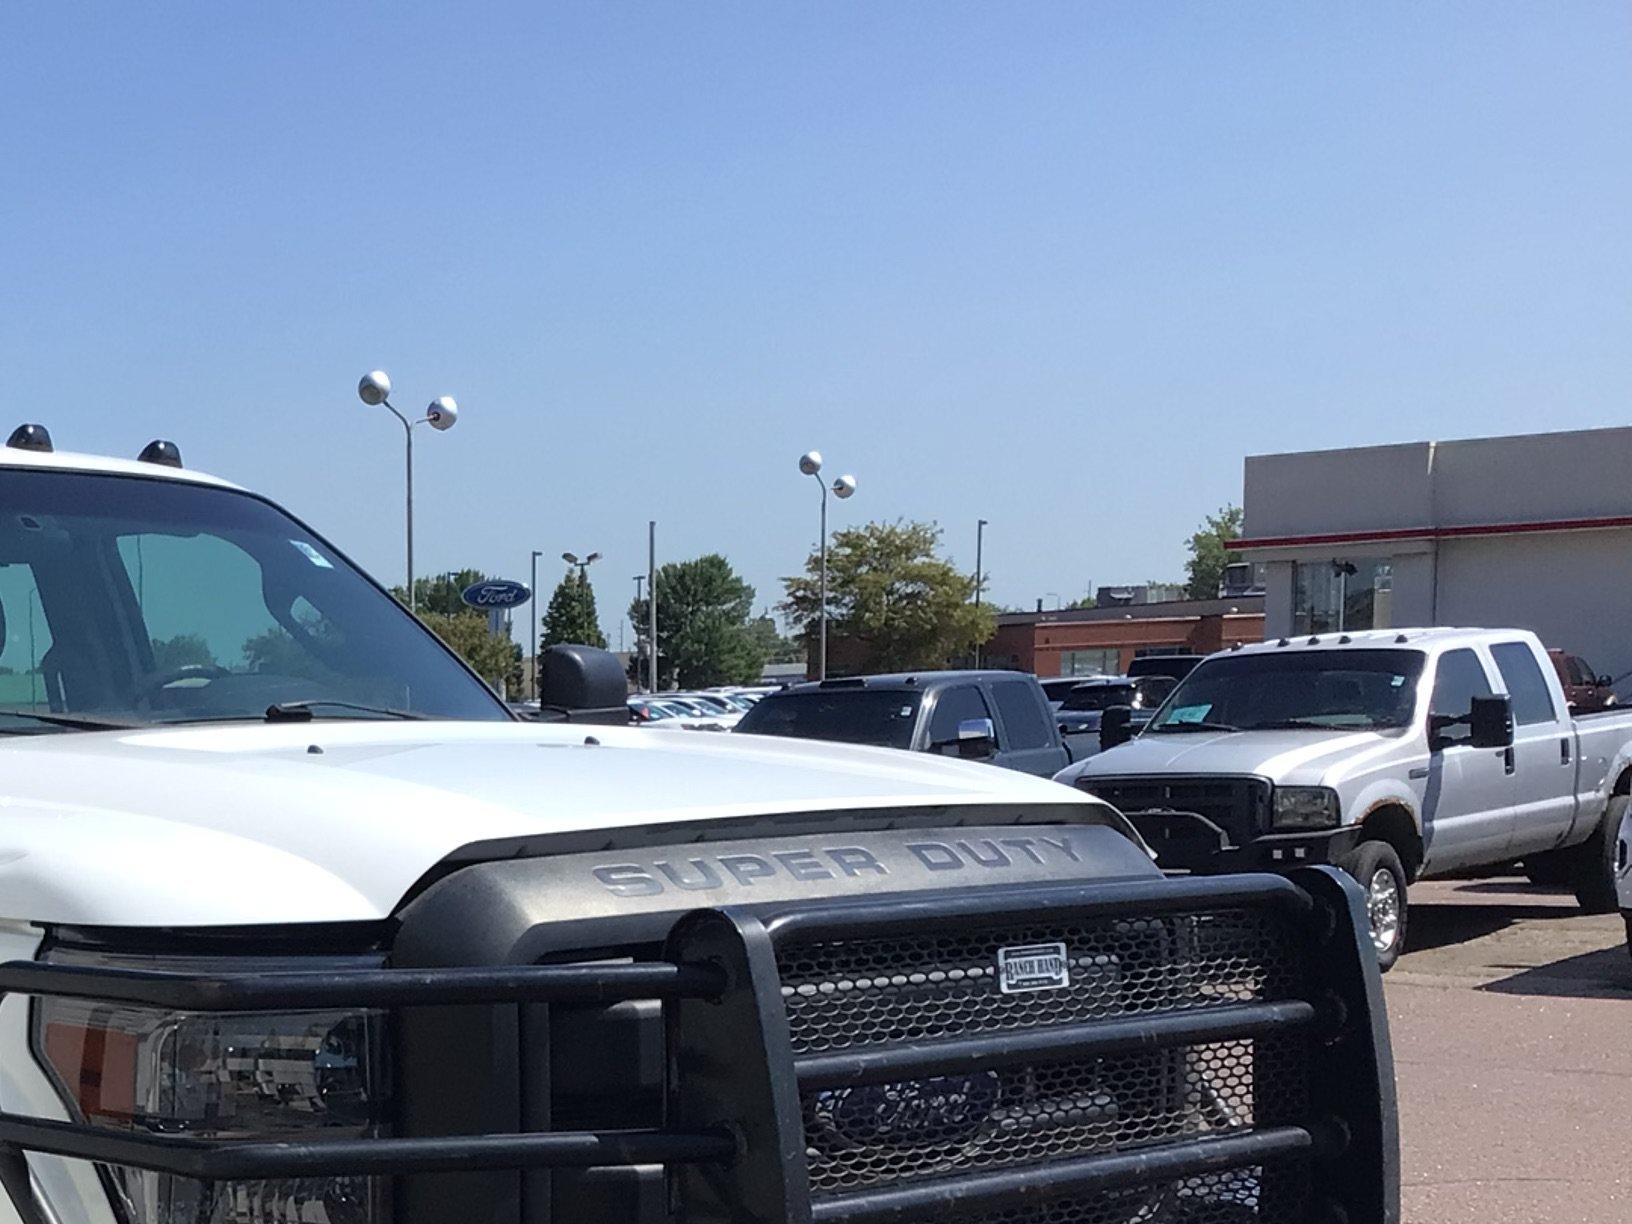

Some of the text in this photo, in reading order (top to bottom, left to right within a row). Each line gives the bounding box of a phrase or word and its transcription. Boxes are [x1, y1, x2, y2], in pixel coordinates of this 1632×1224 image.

[477, 585, 518, 604] Ford
[591, 836, 1085, 898] SUPER DUTY
